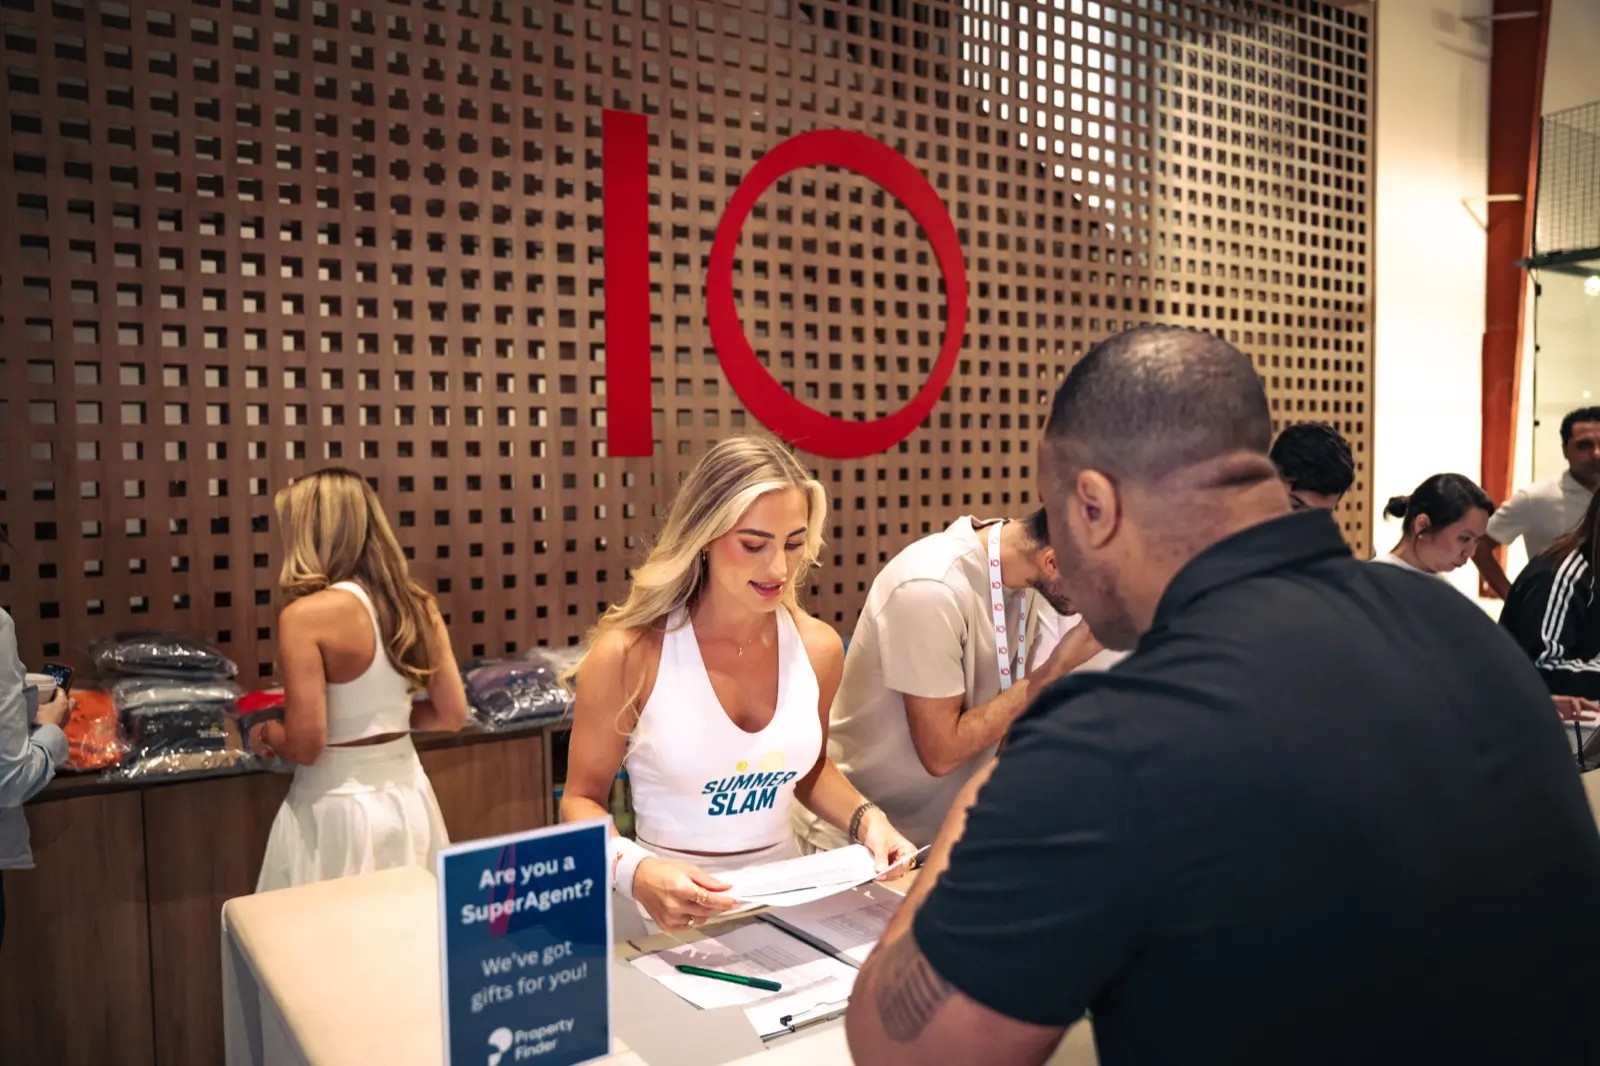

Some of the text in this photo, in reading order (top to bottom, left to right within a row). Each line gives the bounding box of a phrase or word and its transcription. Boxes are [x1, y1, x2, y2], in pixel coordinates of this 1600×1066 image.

[701, 771, 798, 795] SUMMER
[707, 786, 778, 816] SLAM
[479, 855, 575, 889] Are you a
[461, 878, 593, 925] SuperAgent?
[481, 940, 573, 977] We've got
[470, 962, 588, 1013] gifts for you!
[514, 1017, 575, 1043] Property
[515, 1038, 558, 1061] Finder
